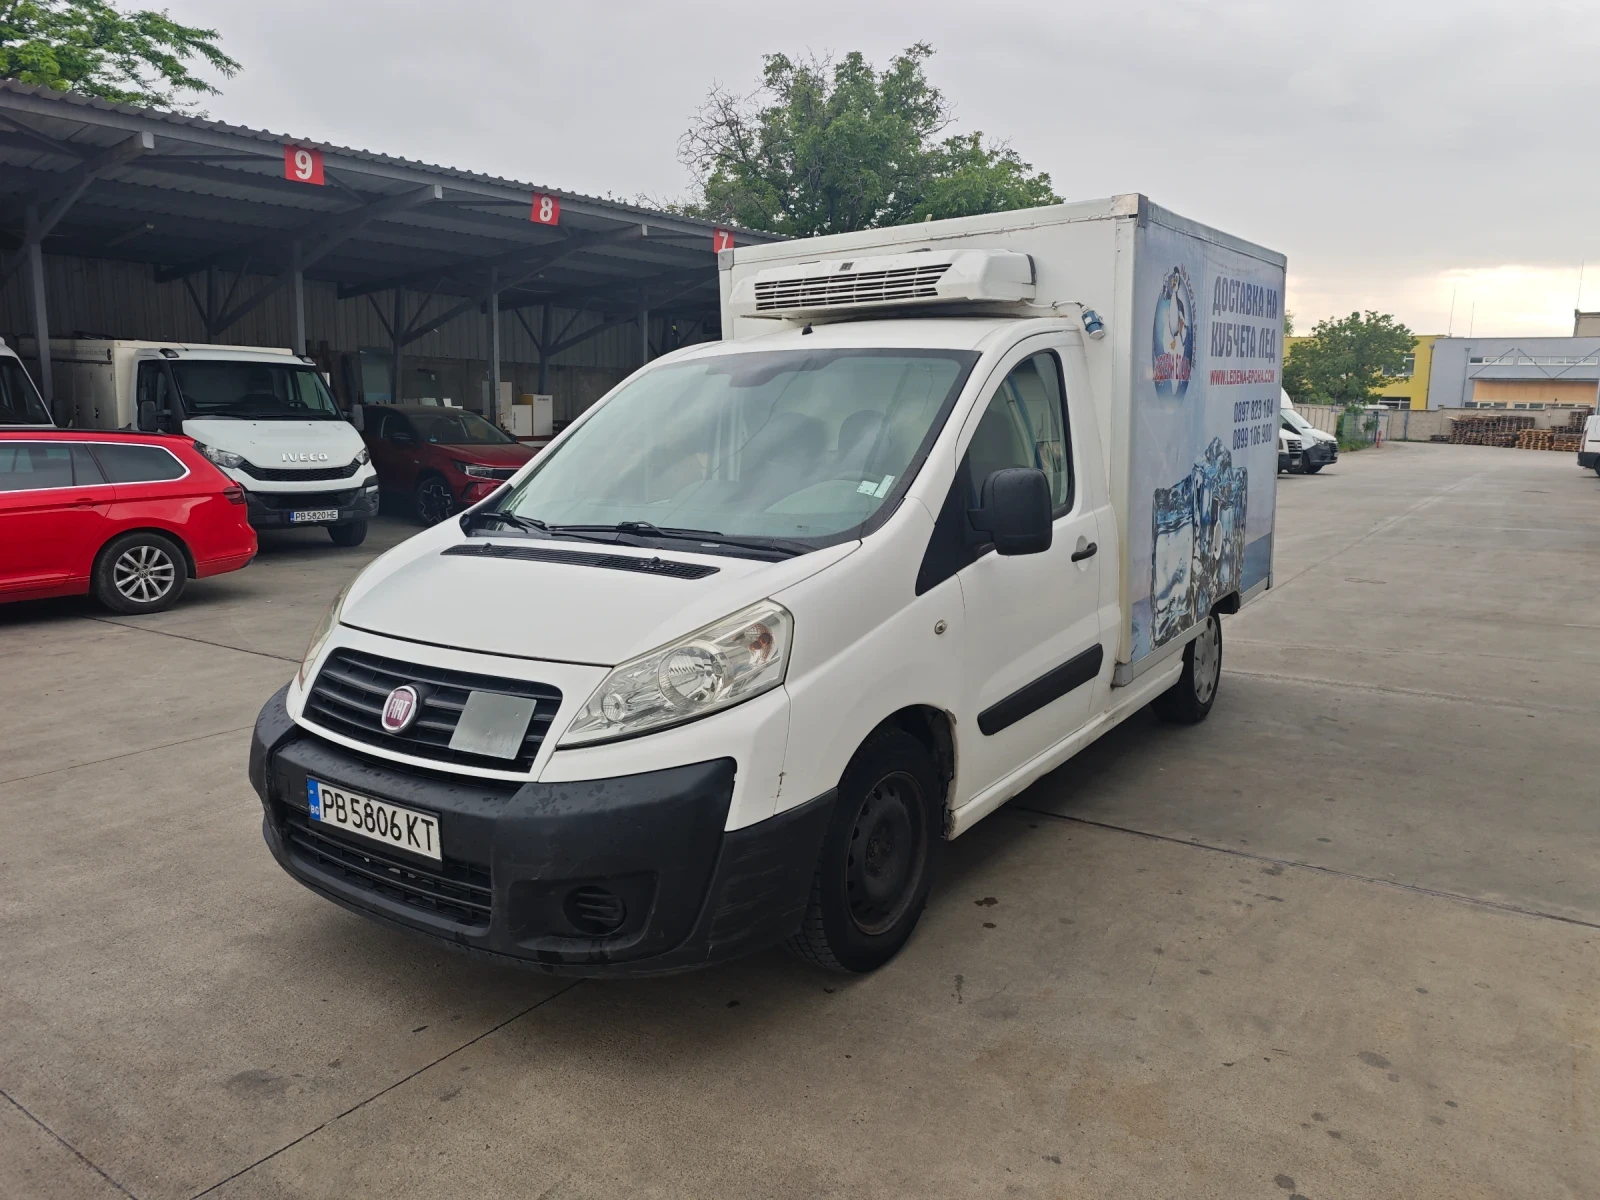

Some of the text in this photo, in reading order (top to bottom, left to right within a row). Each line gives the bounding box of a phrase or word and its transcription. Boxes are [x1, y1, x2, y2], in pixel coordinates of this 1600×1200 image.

[295, 150, 312, 180] 9
[540, 196, 552, 222] 8
[719, 231, 728, 250] 7
[1212, 276, 1278, 320] ДОСТАВКА НА
[1211, 321, 1276, 364] КУБЧЕТА ЛЕД
[1233, 401, 1250, 423] 0897
[1250, 399, 1262, 421] 823
[1232, 427, 1249, 451] 0899
[281, 452, 329, 463] IVECO
[387, 698, 411, 721] FIAT
